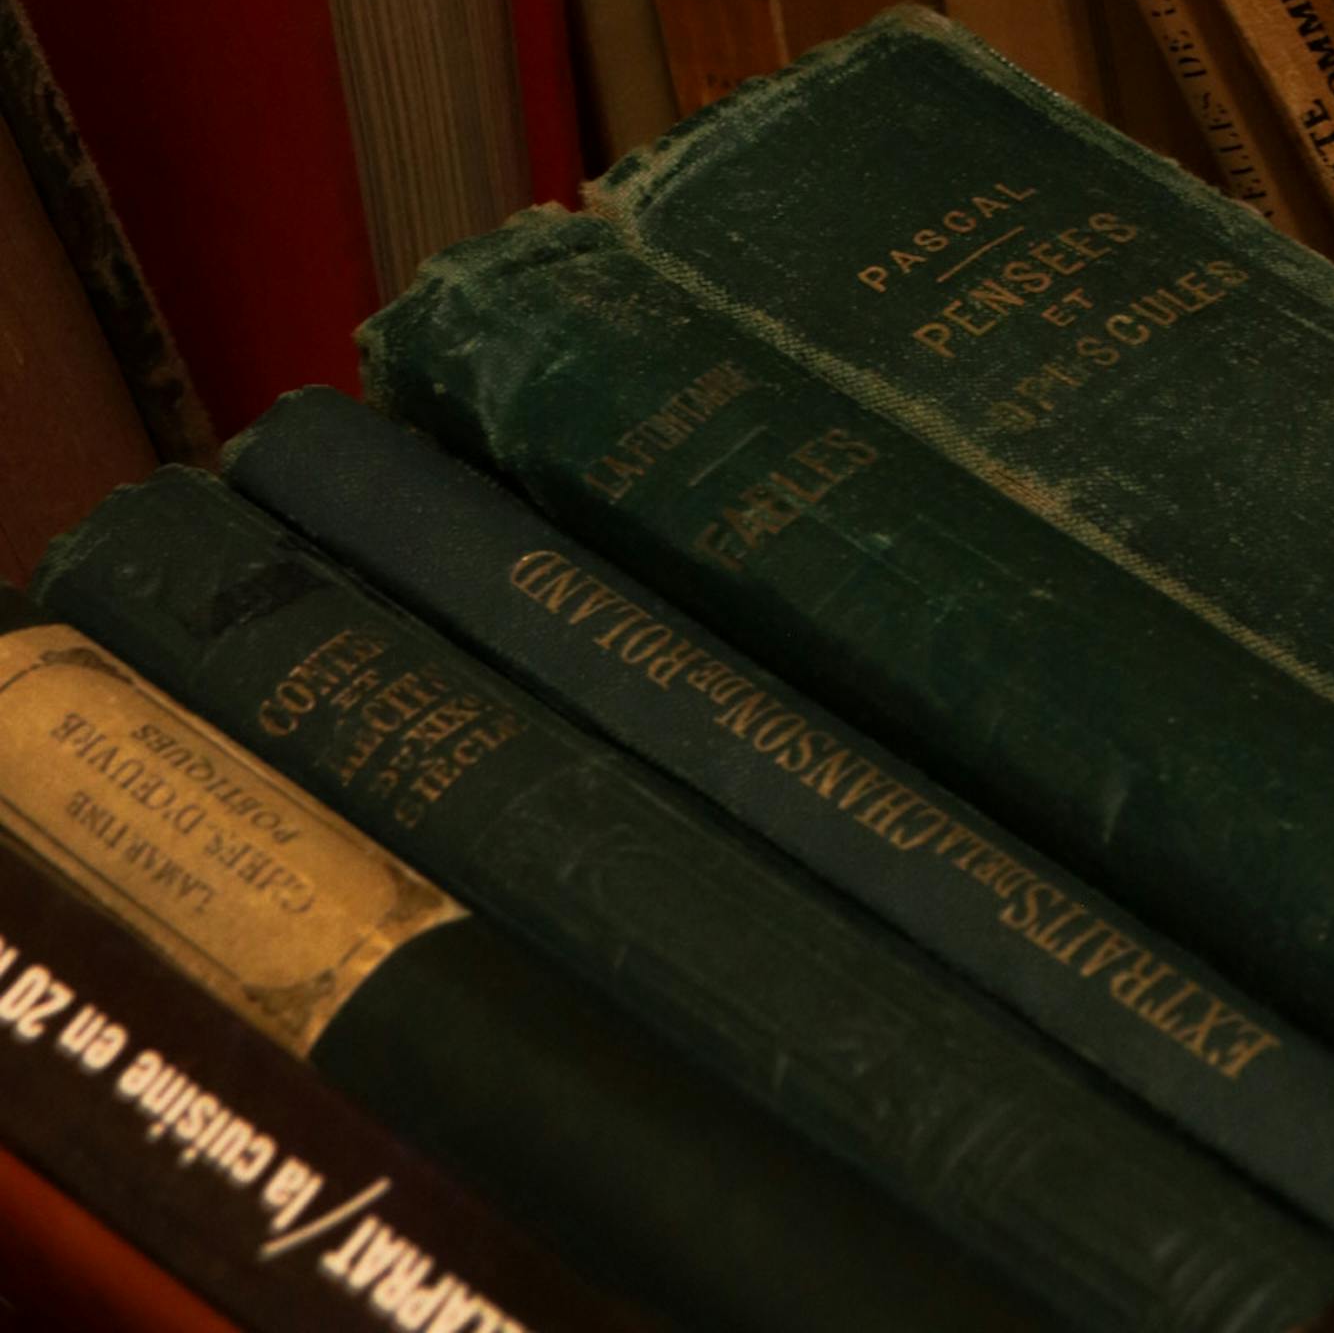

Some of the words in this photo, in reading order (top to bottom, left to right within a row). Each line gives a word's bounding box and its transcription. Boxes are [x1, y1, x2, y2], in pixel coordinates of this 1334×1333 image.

[1163, 30, 1206, 80] DE
[857, 180, 1037, 293] PASCAL
[1041, 286, 1094, 328] ET
[511, 548, 706, 692] ROLAND
[714, 690, 949, 852] CHANSON
[65, 790, 216, 914] LAMARTINE
[55, 1002, 129, 1074] en
[1000, 881, 1281, 1080] EXTRAITS
[114, 1046, 278, 1188] cuisine
[258, 1155, 325, 1233] la
